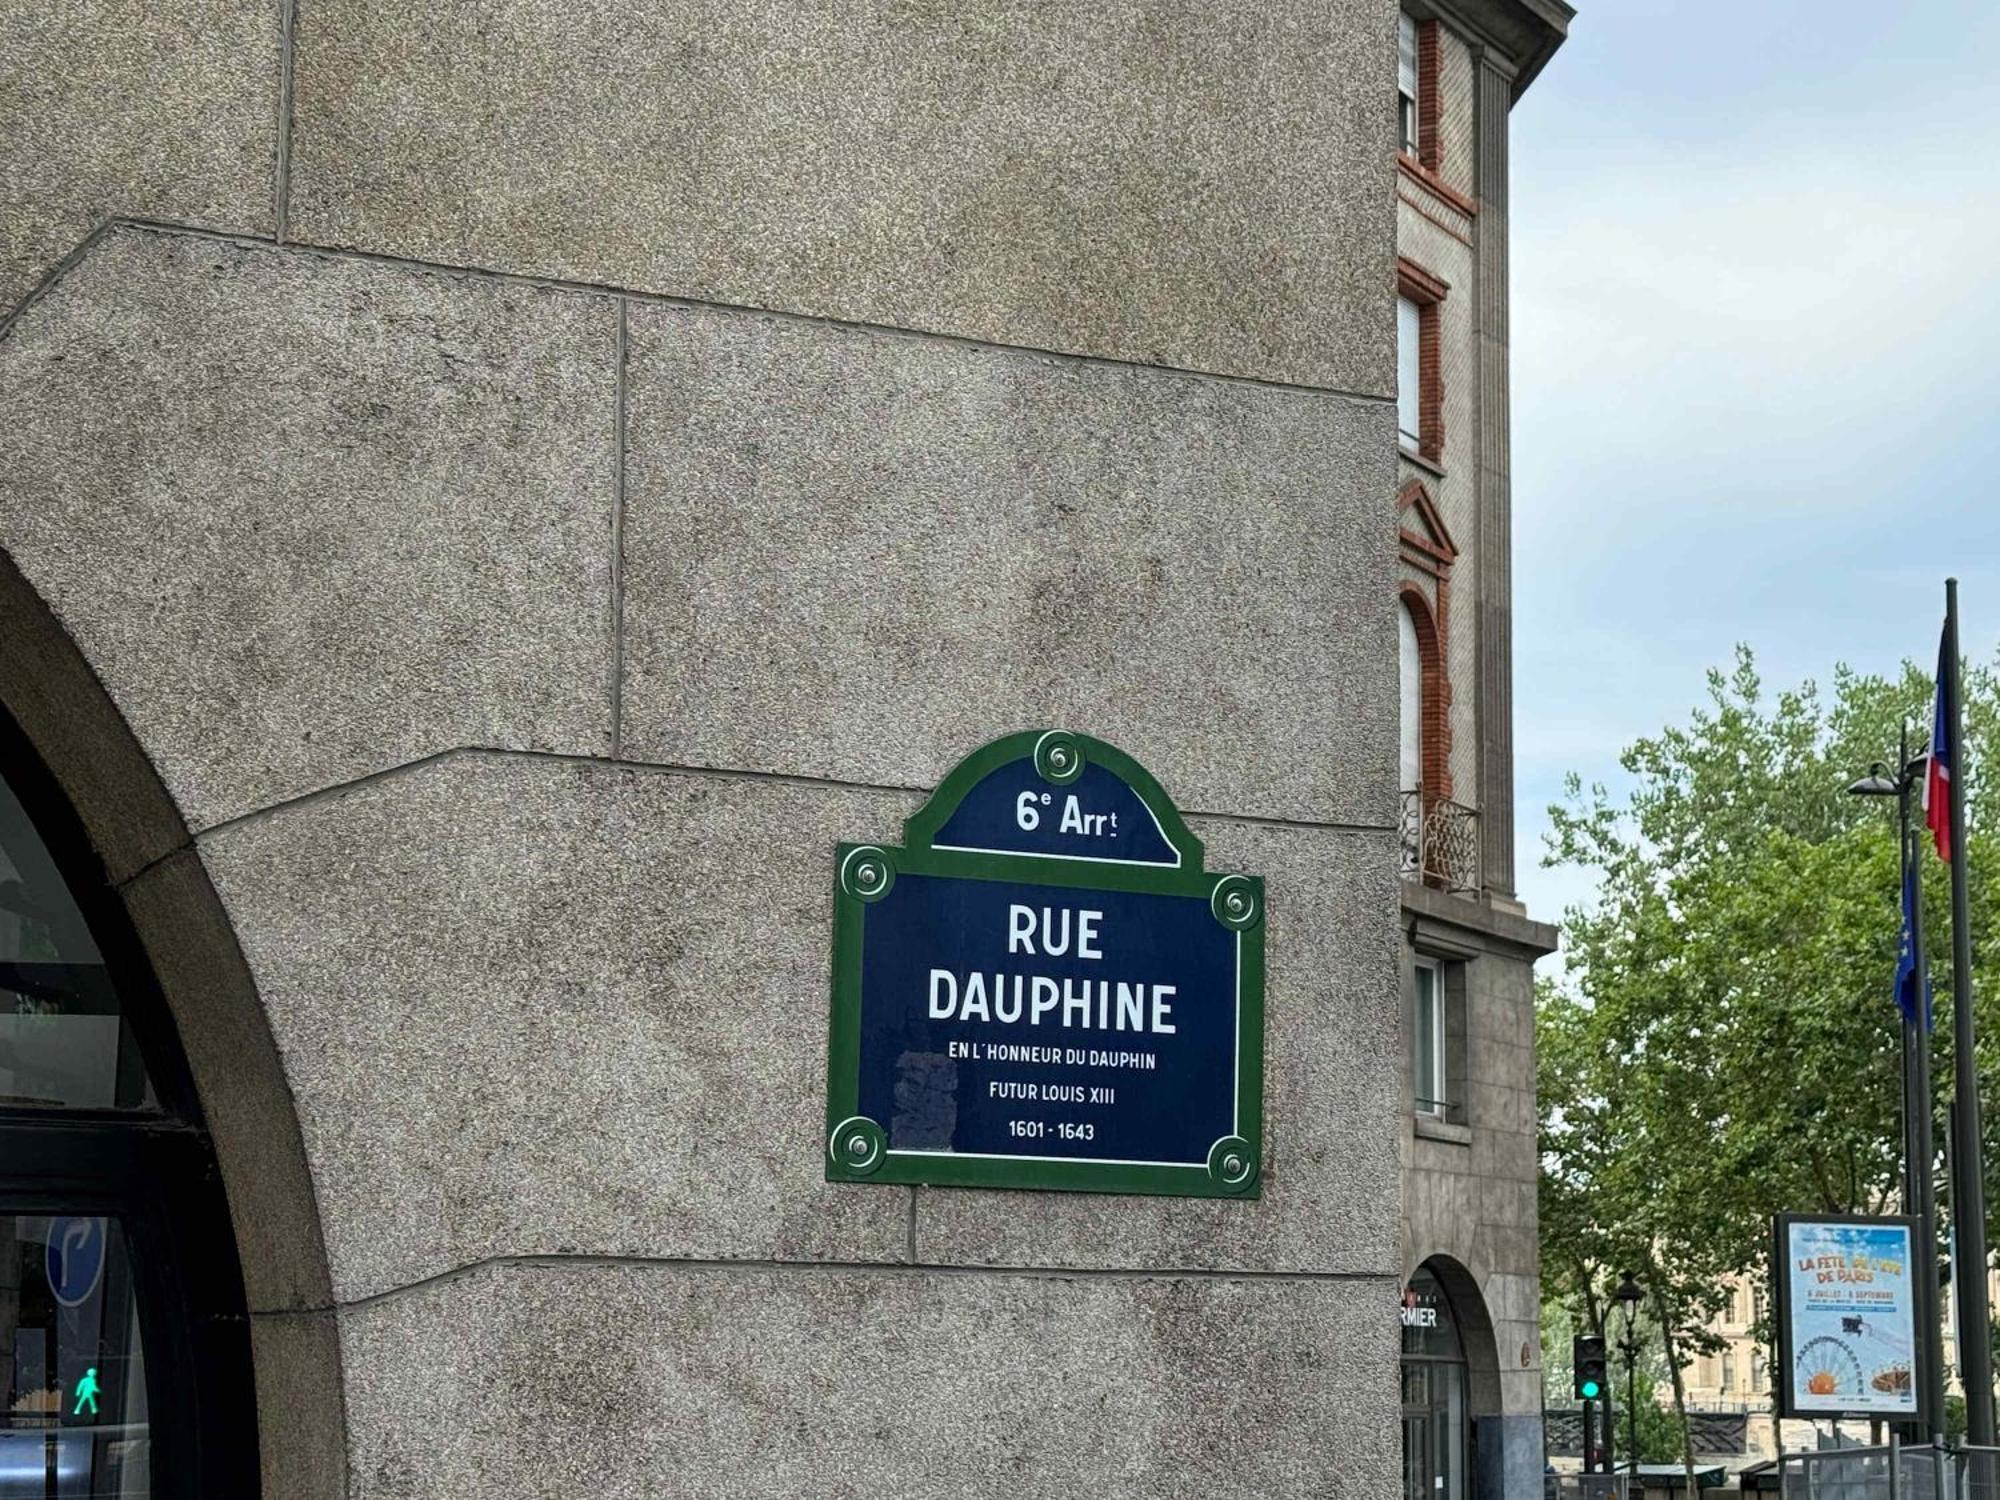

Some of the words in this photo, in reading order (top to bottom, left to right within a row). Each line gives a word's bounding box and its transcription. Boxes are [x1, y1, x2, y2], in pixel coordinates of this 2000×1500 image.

[1008, 903, 1103, 960] RUE
[928, 968, 1177, 1034] DAUPHINE
[949, 1041, 969, 1059] EN
[1065, 1049, 1086, 1066] DU
[1089, 1050, 1156, 1070] DAUPHIN
[989, 1081, 1038, 1100] FUTUR
[1042, 1084, 1085, 1103] LOUIS
[1089, 1087, 1115, 1105] XIII
[1008, 1120, 1044, 1138] 1601
[1057, 1122, 1095, 1140] 1643
[1798, 1258, 1815, 1271] LA
[1816, 1270, 1835, 1284] DE
[1837, 1269, 1874, 1284] PARIS
